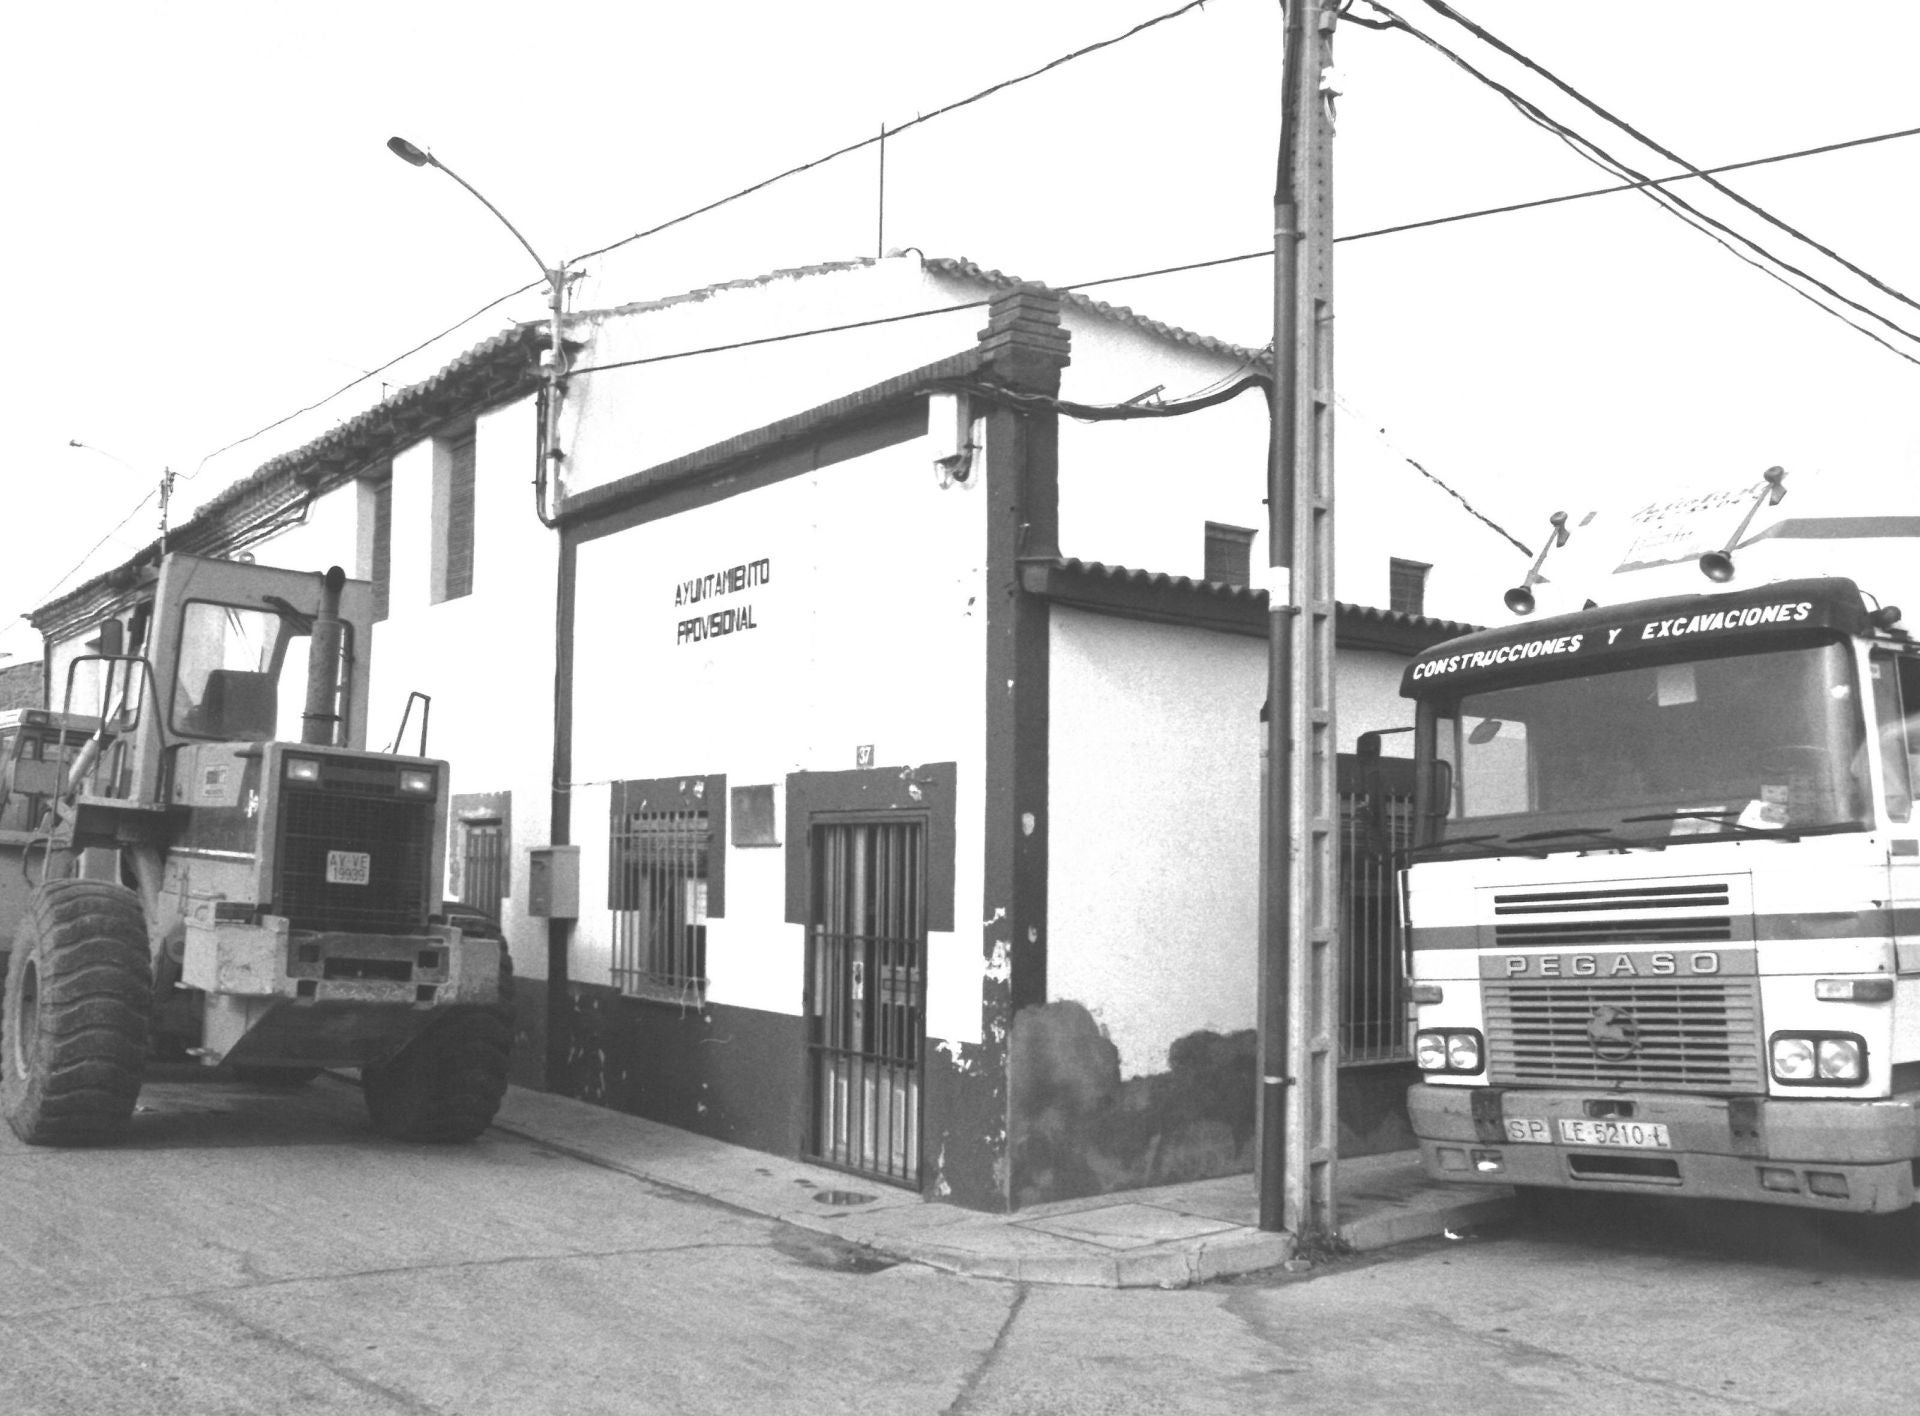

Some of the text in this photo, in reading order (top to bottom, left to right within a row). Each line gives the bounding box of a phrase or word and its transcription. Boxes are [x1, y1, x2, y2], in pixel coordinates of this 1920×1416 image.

[675, 558, 770, 607] AYUNTAMIENTO
[676, 604, 757, 646] PROVISIONAL
[1413, 602, 1813, 680] CONSTRUCCIONES Y EXCAVACIONES
[859, 746, 872, 765] 37
[1505, 952, 1719, 977] PEGASO
[1508, 1120, 1544, 1140] SP
